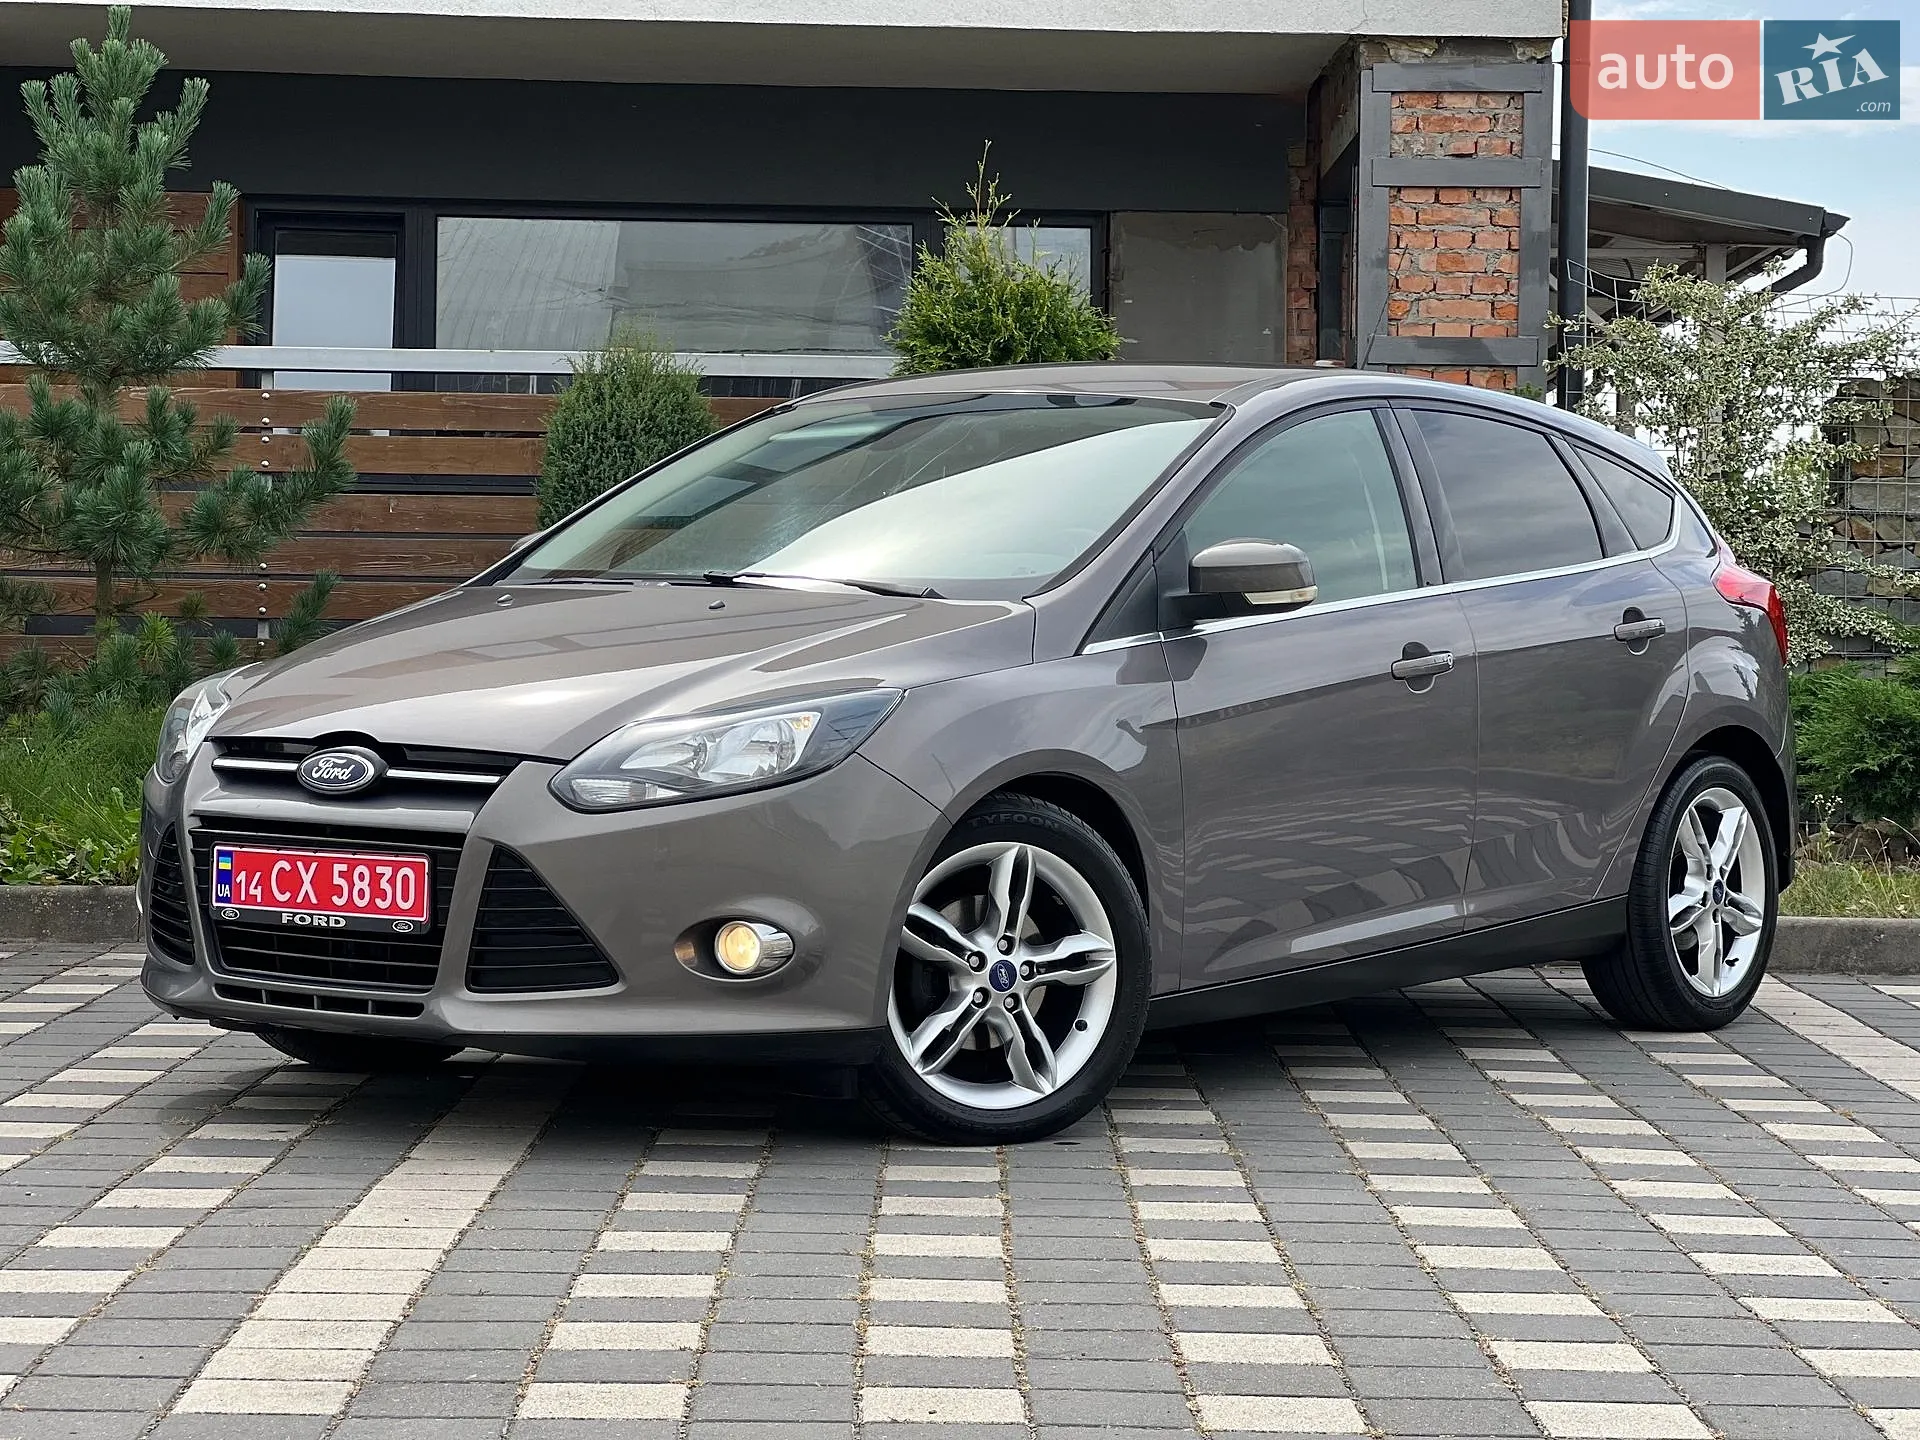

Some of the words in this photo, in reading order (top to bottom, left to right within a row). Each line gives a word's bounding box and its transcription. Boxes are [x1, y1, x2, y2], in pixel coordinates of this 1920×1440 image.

[311, 757, 356, 780] Ford
[217, 883, 231, 898] UA
[235, 869, 262, 904] 14
[270, 859, 319, 905] CX
[331, 863, 416, 910] 5830
[281, 912, 347, 928] FORD
